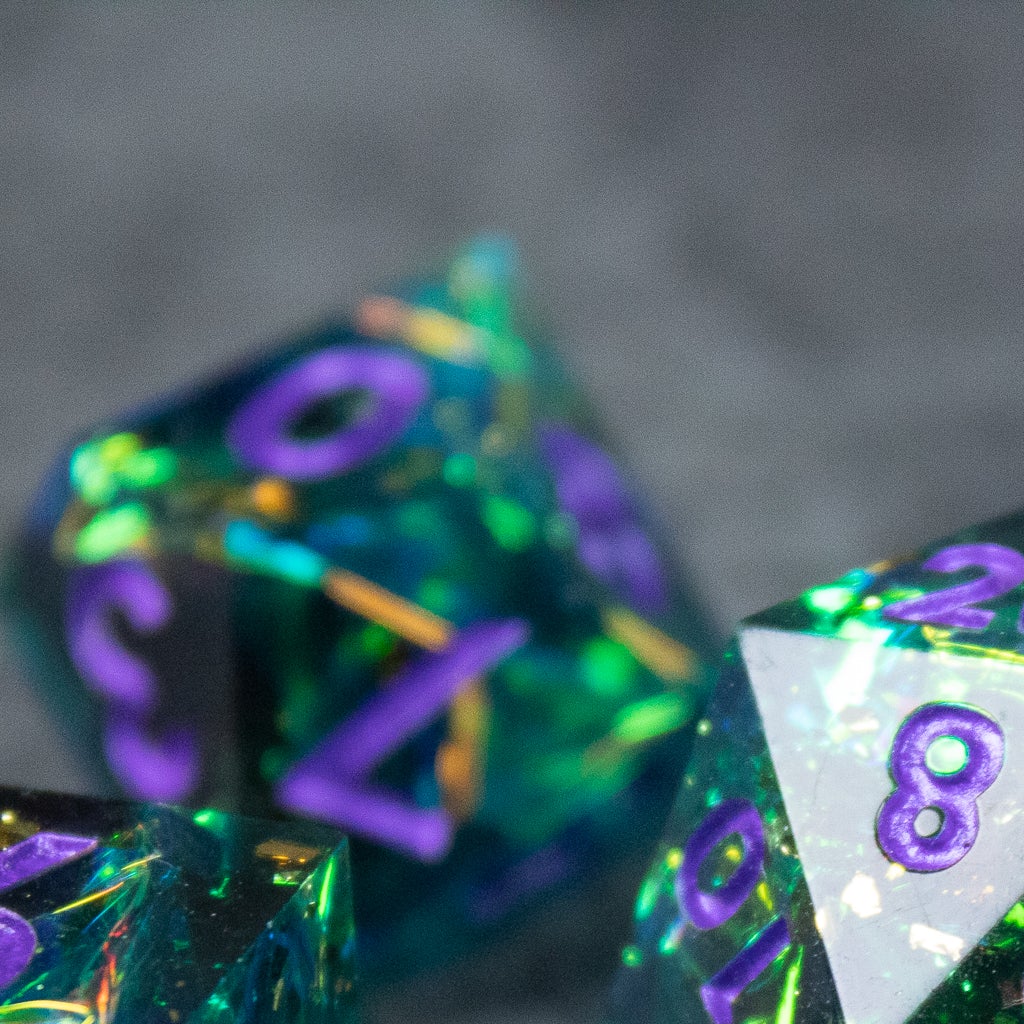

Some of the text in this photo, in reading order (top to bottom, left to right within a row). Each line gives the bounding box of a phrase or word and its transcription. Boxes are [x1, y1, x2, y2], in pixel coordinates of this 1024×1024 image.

[232, 348, 428, 480] 0
[275, 618, 530, 862] 7
[876, 702, 1004, 873] 8
